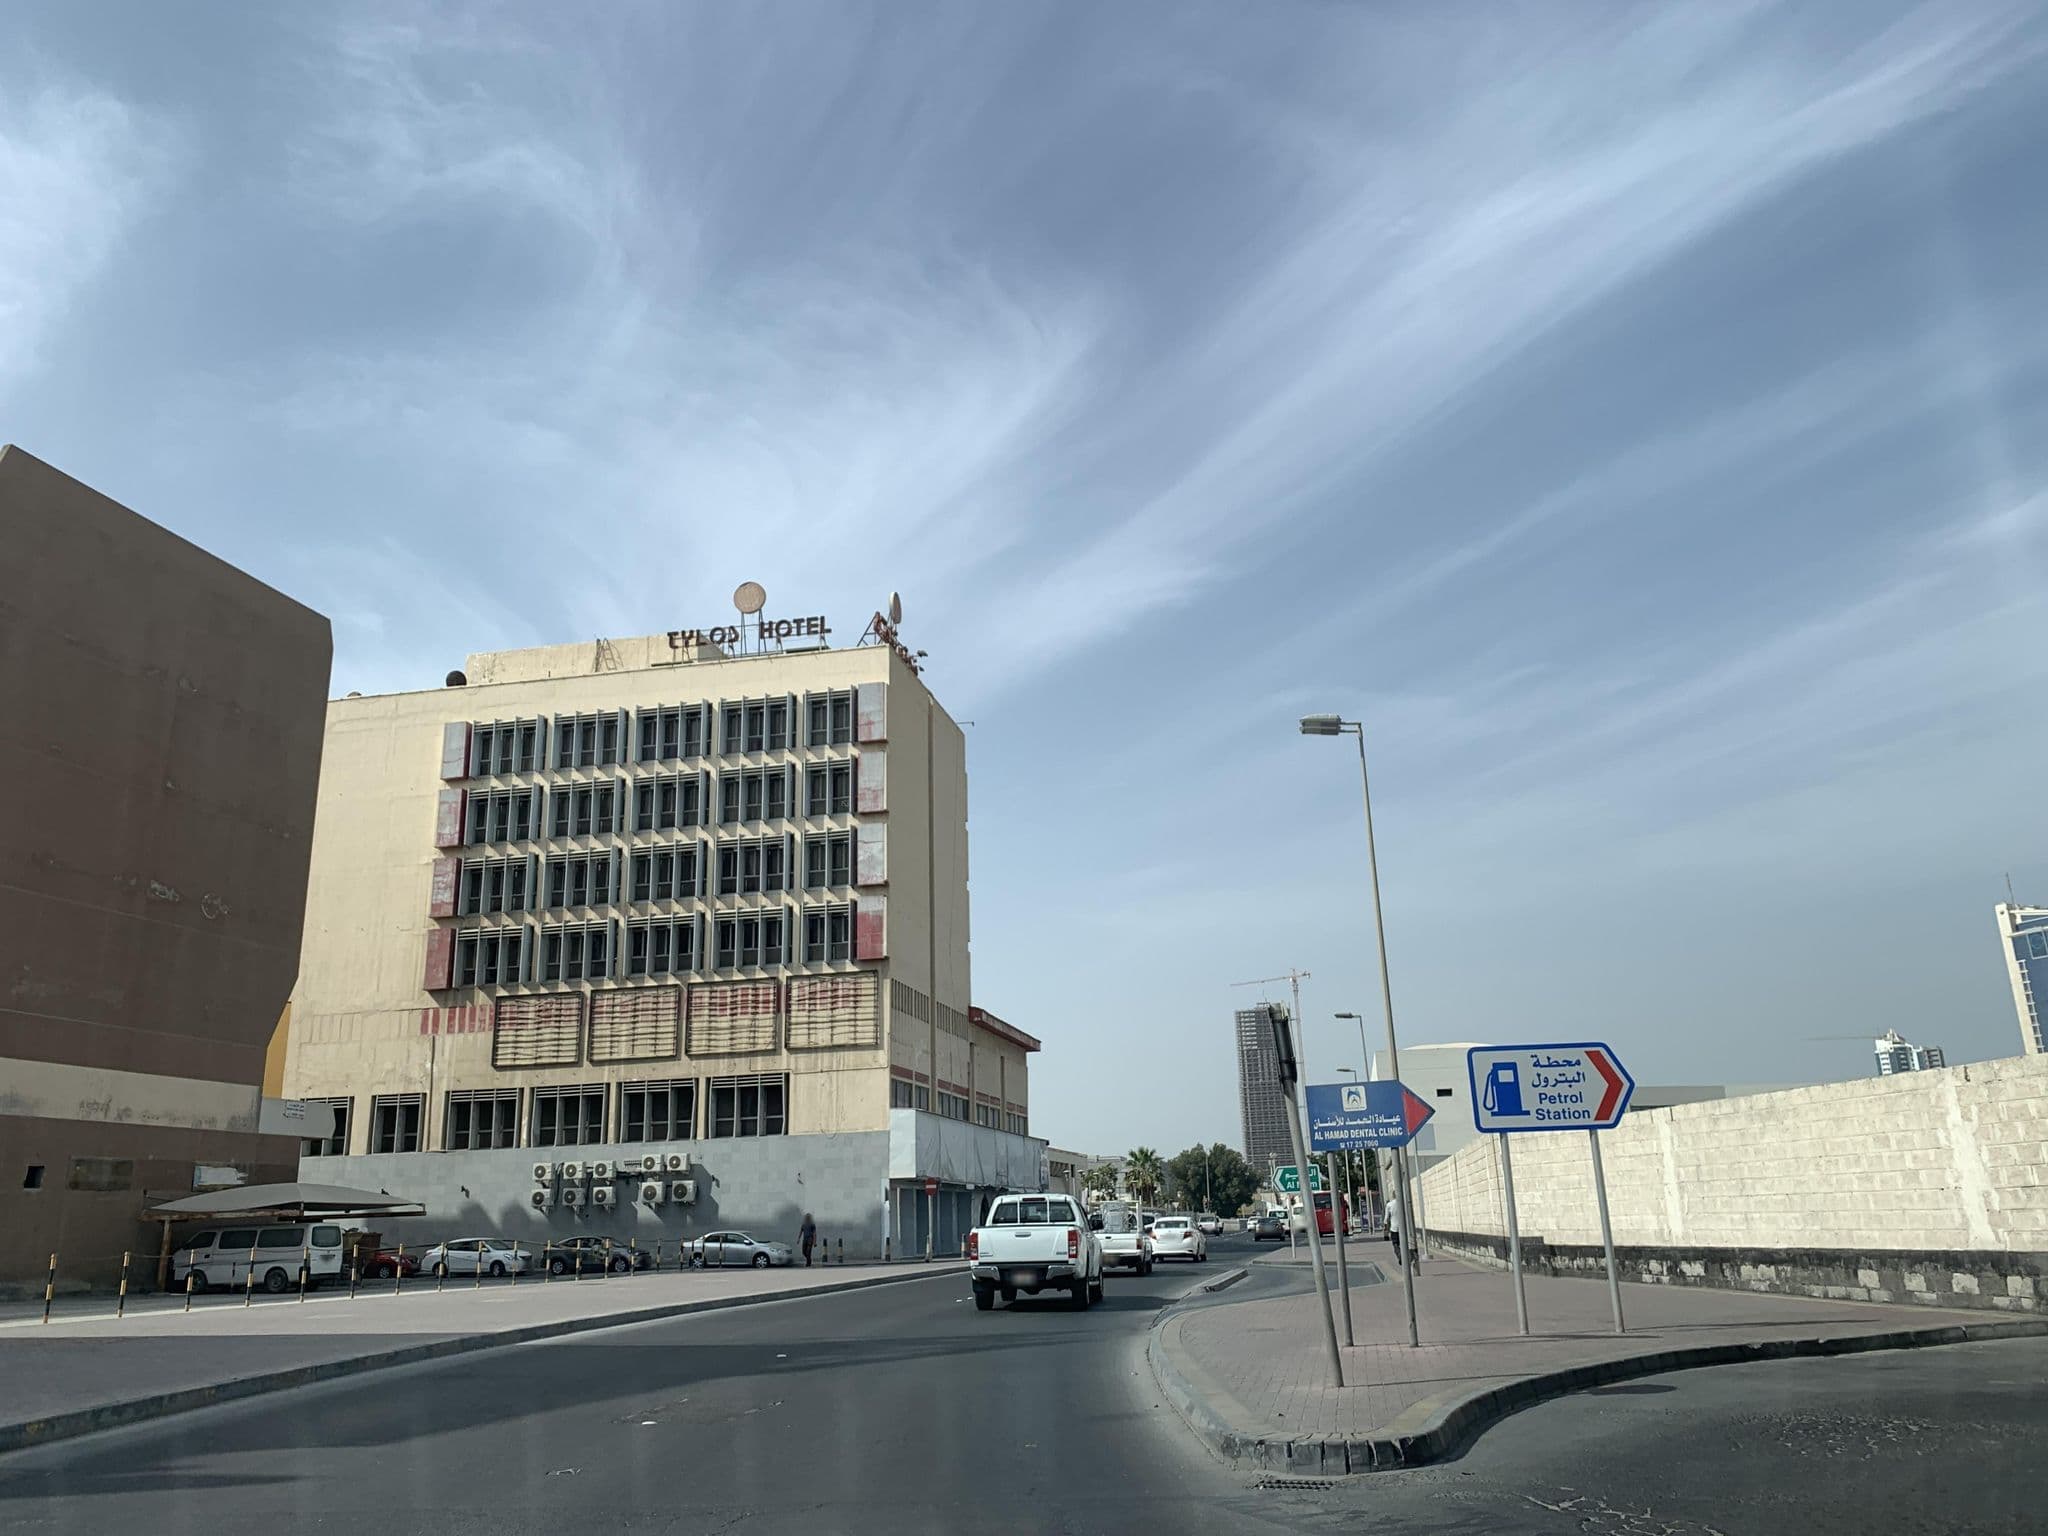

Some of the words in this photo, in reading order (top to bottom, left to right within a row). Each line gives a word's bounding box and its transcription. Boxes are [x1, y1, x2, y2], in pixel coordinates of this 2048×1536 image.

[760, 616, 832, 640] HOTEL
[1530, 1054, 1581, 1069] محطة
[1532, 1071, 1586, 1088] البترول
[1539, 1091, 1583, 1104] Petrol
[1375, 1114, 1401, 1125] عيادة
[1535, 1108, 1591, 1121] Station
[1314, 1131, 1323, 1140] AL
[1324, 1130, 1349, 1139] HAMAD
[1350, 1128, 1377, 1138] DENTAL
[1378, 1127, 1403, 1136] CLINIC
[1286, 1181, 1295, 1189] Al
